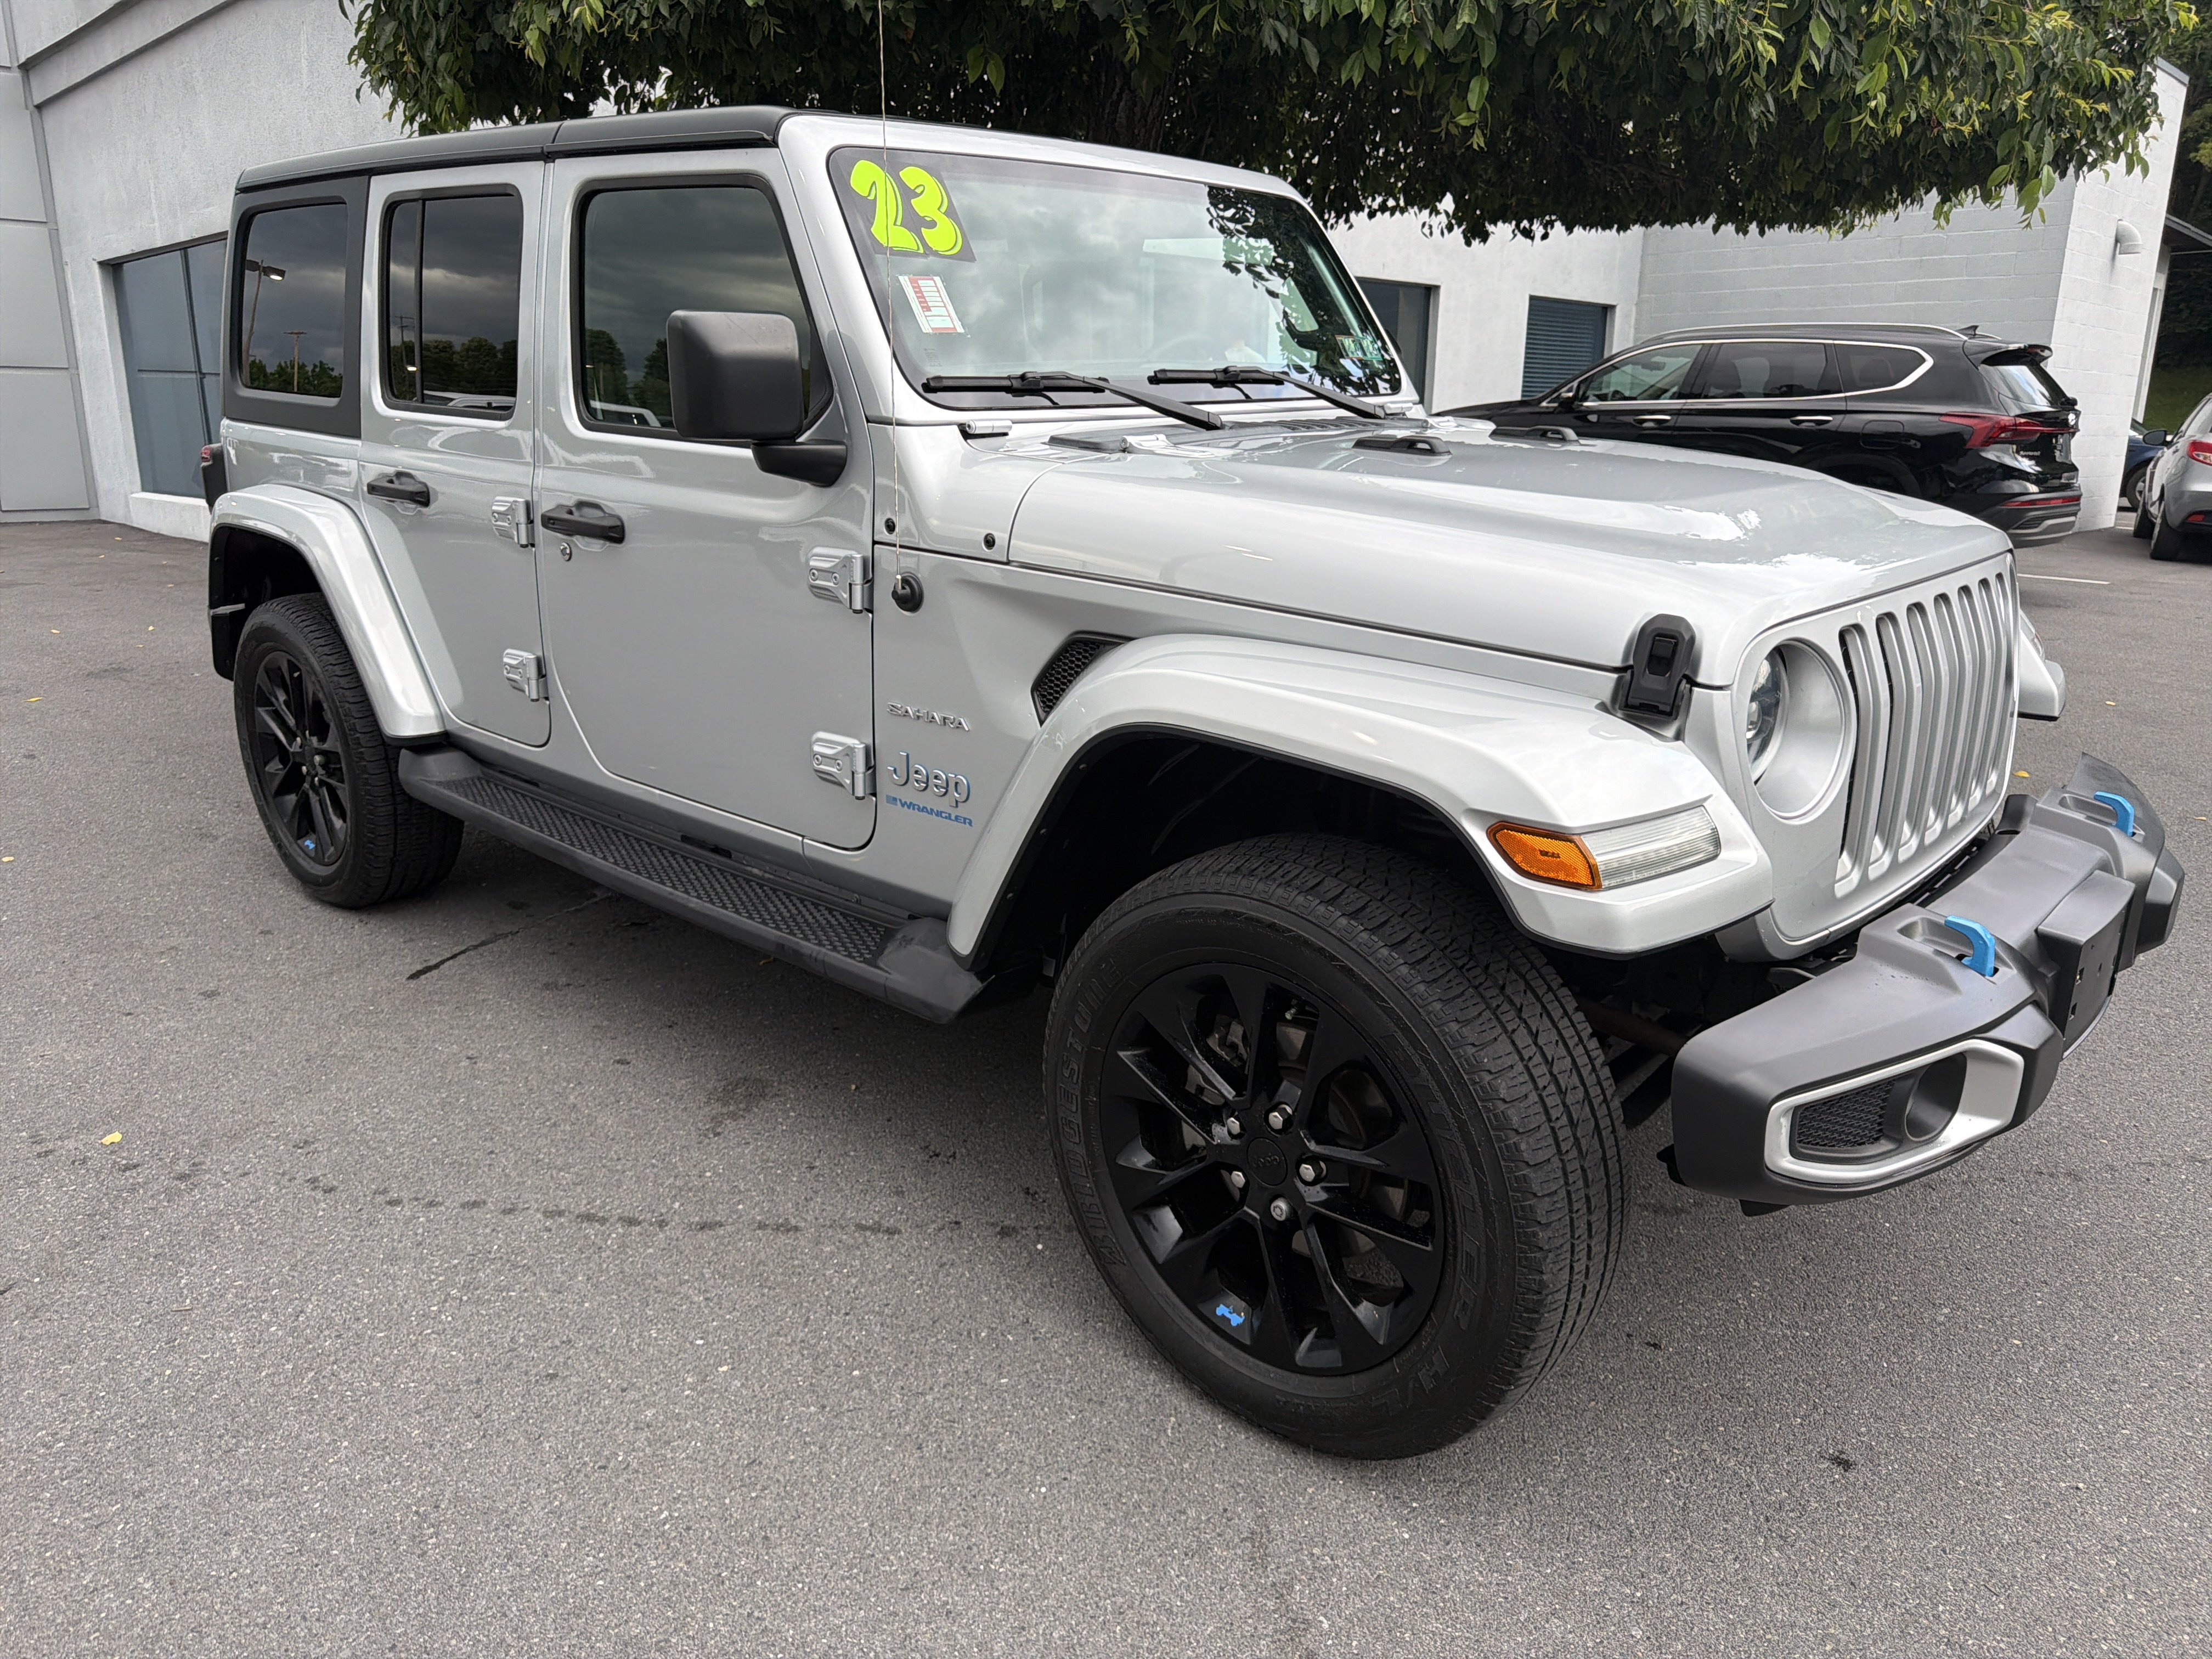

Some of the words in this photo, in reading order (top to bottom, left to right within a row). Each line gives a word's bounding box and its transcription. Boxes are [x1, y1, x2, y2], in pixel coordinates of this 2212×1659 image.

[850, 160, 963, 255] 23
[887, 702, 970, 732] SAHARA
[887, 751, 970, 809] Jeep
[898, 798, 973, 827] WRANGLER
[1056, 957, 1126, 1266] BRIDGESTONE
